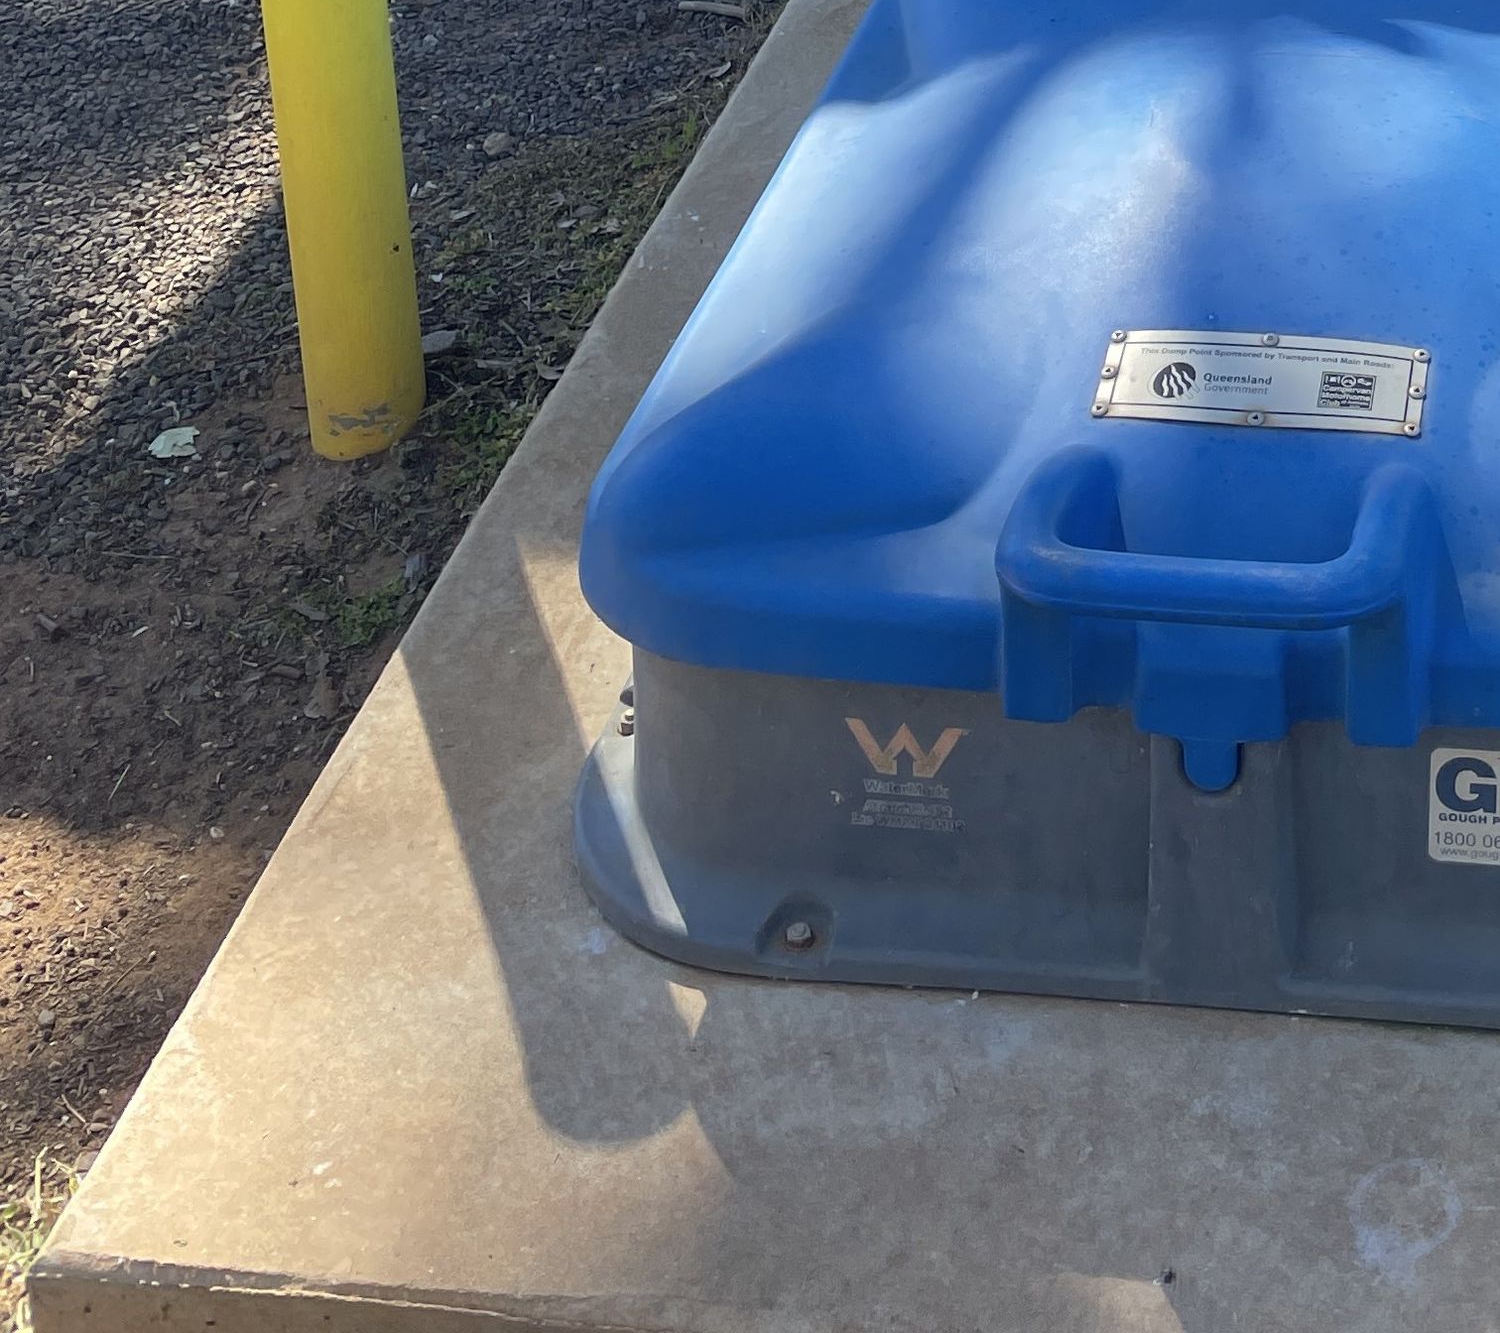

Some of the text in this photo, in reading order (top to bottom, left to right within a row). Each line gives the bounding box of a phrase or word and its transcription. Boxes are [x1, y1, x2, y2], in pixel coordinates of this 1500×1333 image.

[1161, 348, 1187, 356] Dump
[1189, 348, 1212, 357] Point
[1214, 349, 1263, 359] Sponsored
[1264, 353, 1275, 361] by
[1278, 353, 1319, 363] Transport
[1321, 356, 1338, 364] and
[1340, 357, 1361, 366] Main
[1203, 373, 1272, 385] Queensland
[1204, 384, 1268, 395] Government
[1438, 812, 1488, 825] GOUGH
[1434, 831, 1476, 847] 1800
